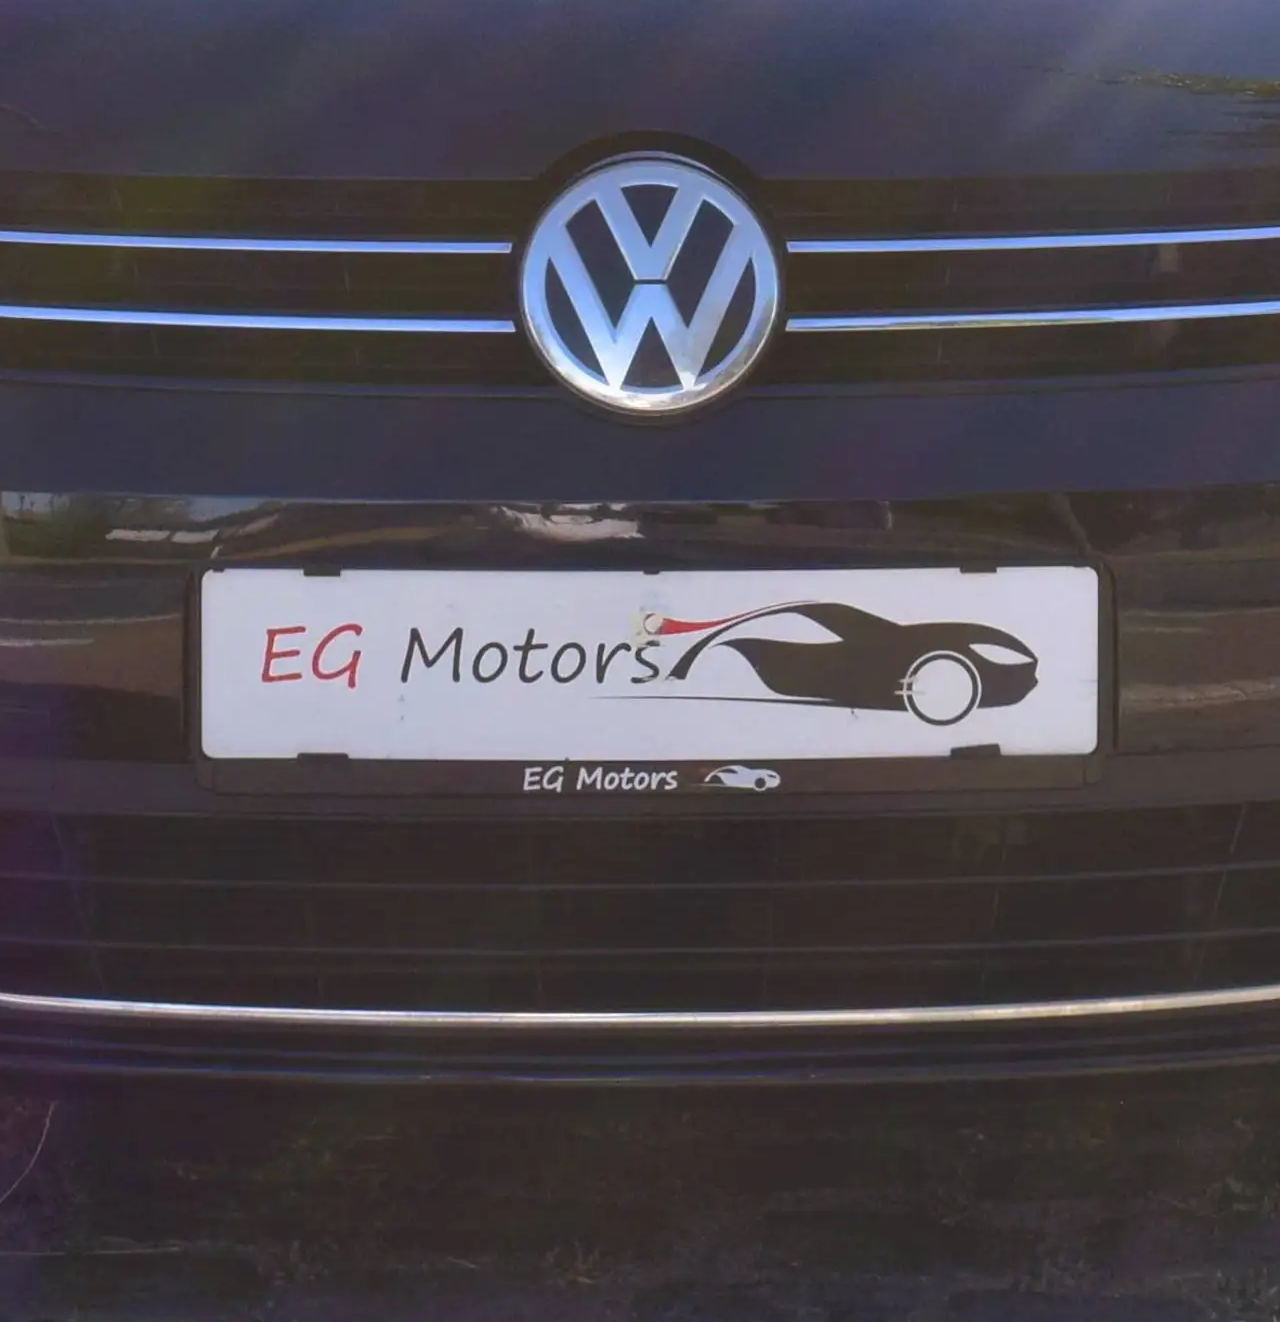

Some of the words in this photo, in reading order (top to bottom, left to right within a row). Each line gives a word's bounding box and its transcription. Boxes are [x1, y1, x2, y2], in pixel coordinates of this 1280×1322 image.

[531, 166, 770, 405] VW
[261, 623, 364, 689] EG
[400, 626, 660, 685] Motors
[523, 765, 564, 793] EG
[576, 766, 678, 791] Motors
